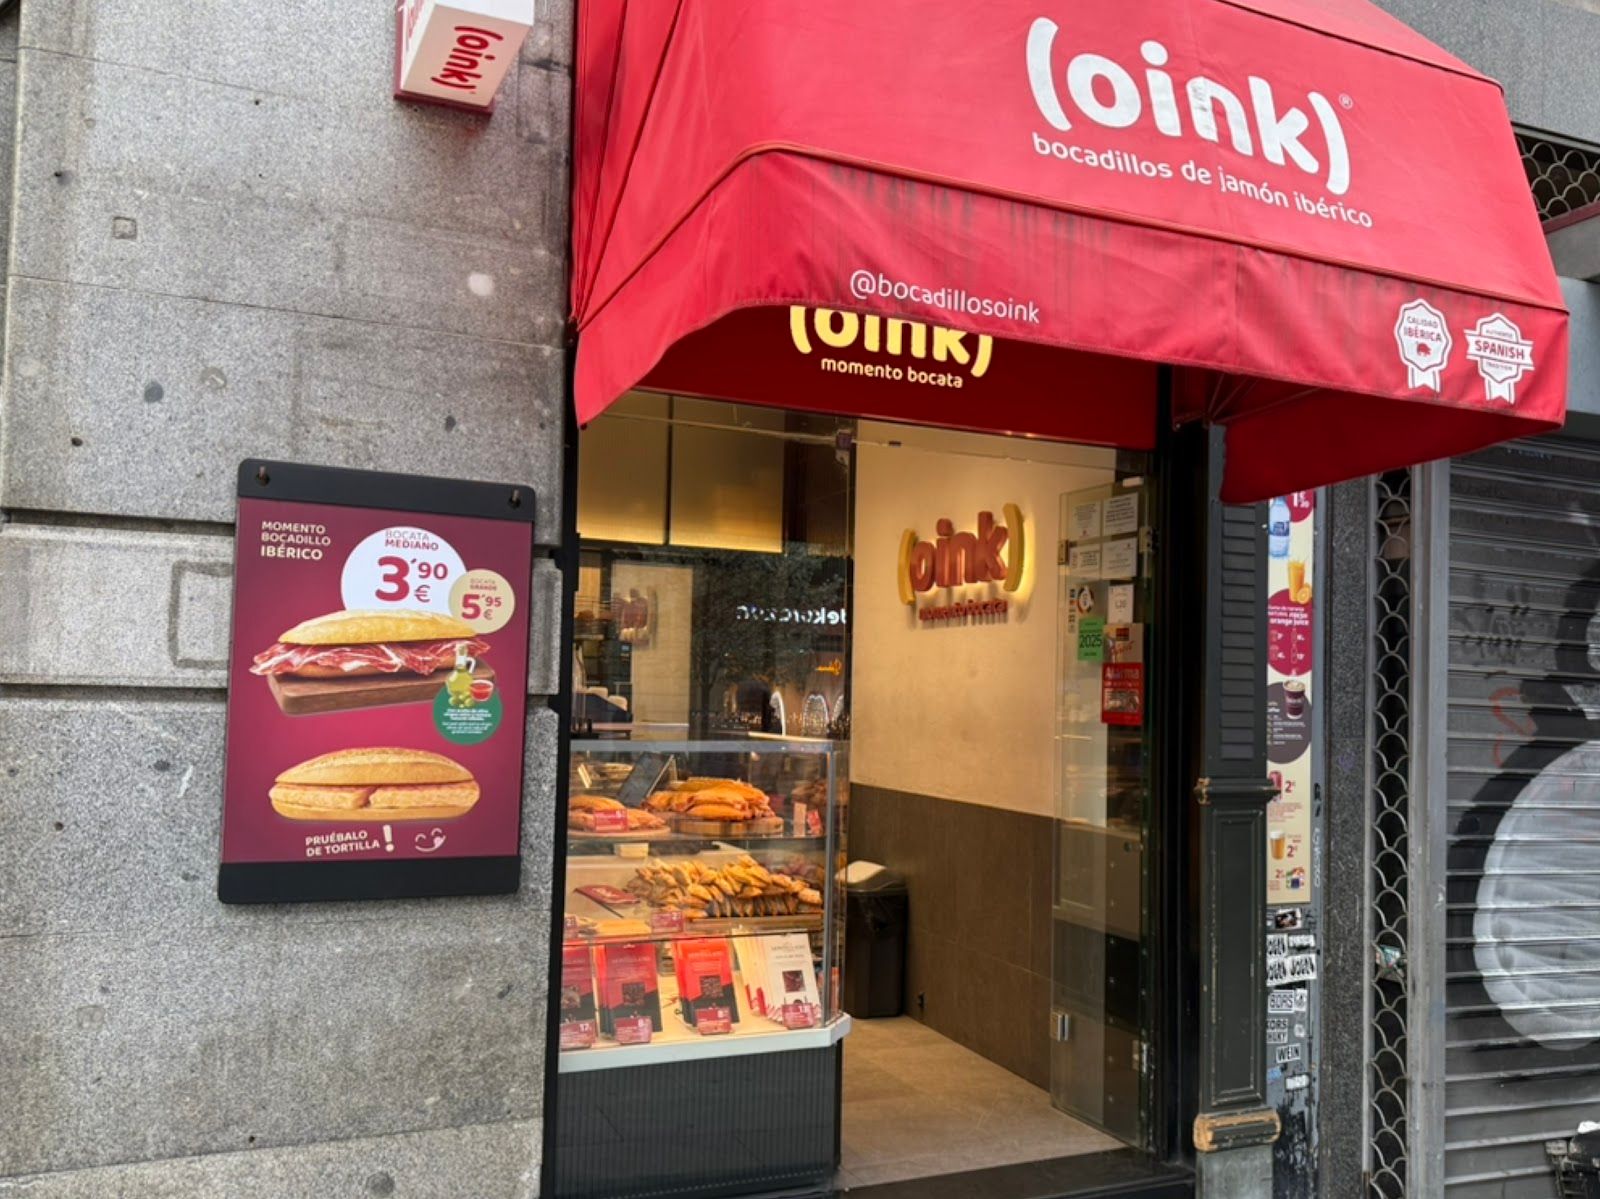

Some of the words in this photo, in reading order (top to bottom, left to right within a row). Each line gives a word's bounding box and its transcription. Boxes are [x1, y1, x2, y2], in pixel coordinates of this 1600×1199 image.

[1032, 132, 1173, 178] bocadillos
[1181, 160, 1212, 184] de
[1217, 166, 1289, 208] jamón
[1293, 191, 1373, 228] ibérico
[850, 269, 1039, 324] @bocadillosoink
[1406, 316, 1439, 328] CALIDAD
[1404, 326, 1442, 342] IBÉRICA
[1474, 339, 1525, 361] SPANISH
[820, 357, 903, 381] momento
[907, 366, 964, 389] bocata
[261, 521, 326, 535] MOMENTO
[385, 530, 430, 541] BOCATA
[261, 531, 331, 546] BOCADILLO
[385, 538, 439, 551] MEDIANO
[260, 543, 323, 560] IBÉRICO
[305, 830, 368, 846] PRUÉBALO
[306, 846, 322, 857] DE
[325, 839, 381, 854] TORTILLA
